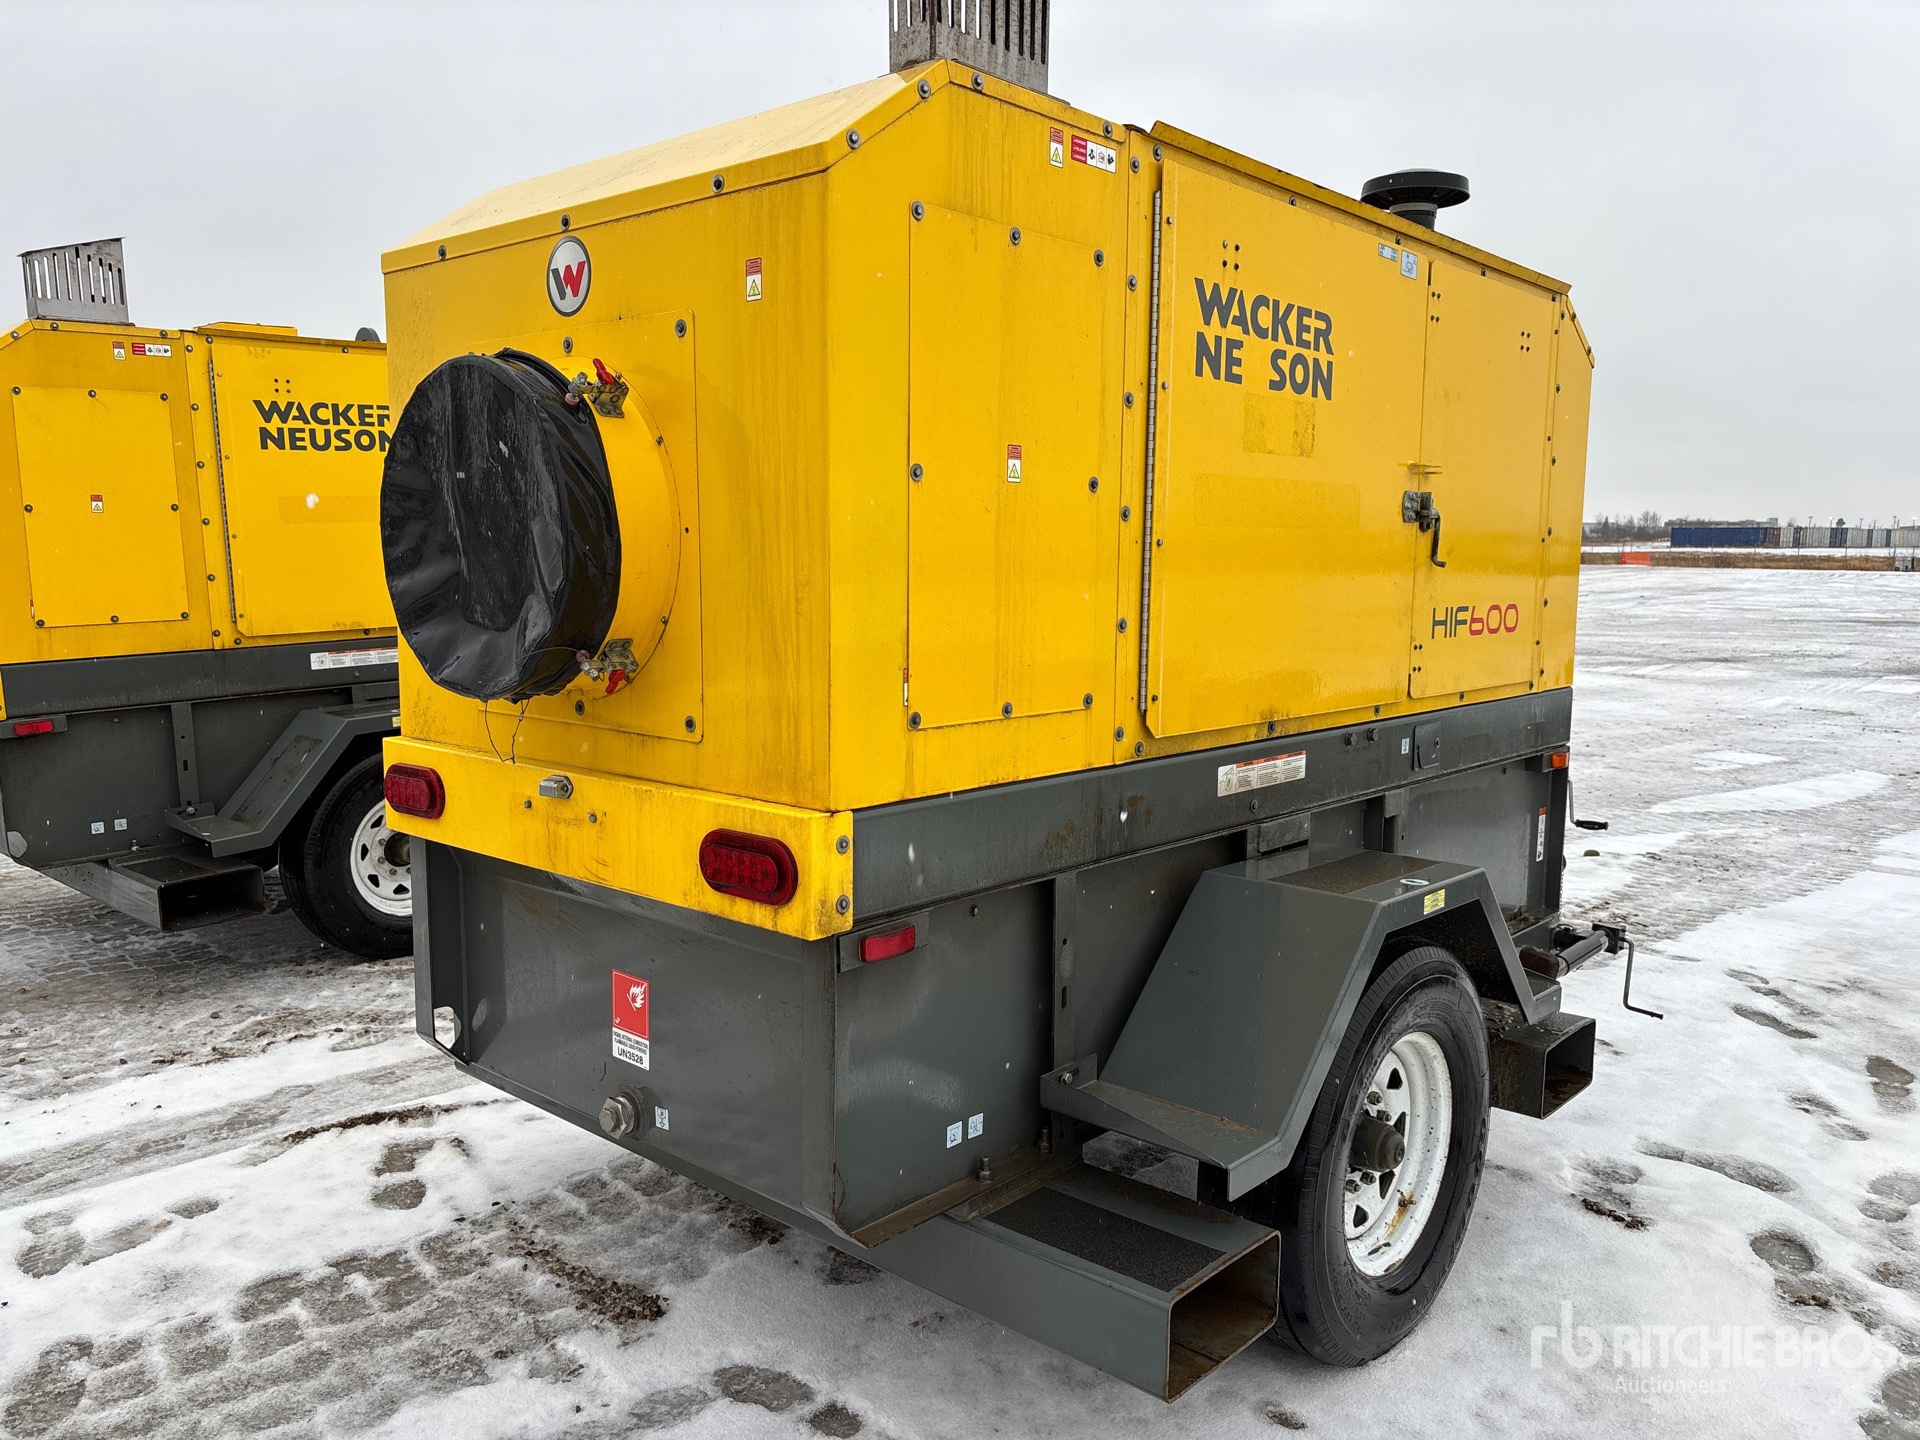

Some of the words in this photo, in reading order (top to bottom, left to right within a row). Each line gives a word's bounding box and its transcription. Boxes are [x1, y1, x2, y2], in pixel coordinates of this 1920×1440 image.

[1194, 277, 1335, 356] WACKER
[1431, 603, 1519, 640] HIF600
[617, 1046, 643, 1065] UN3528
